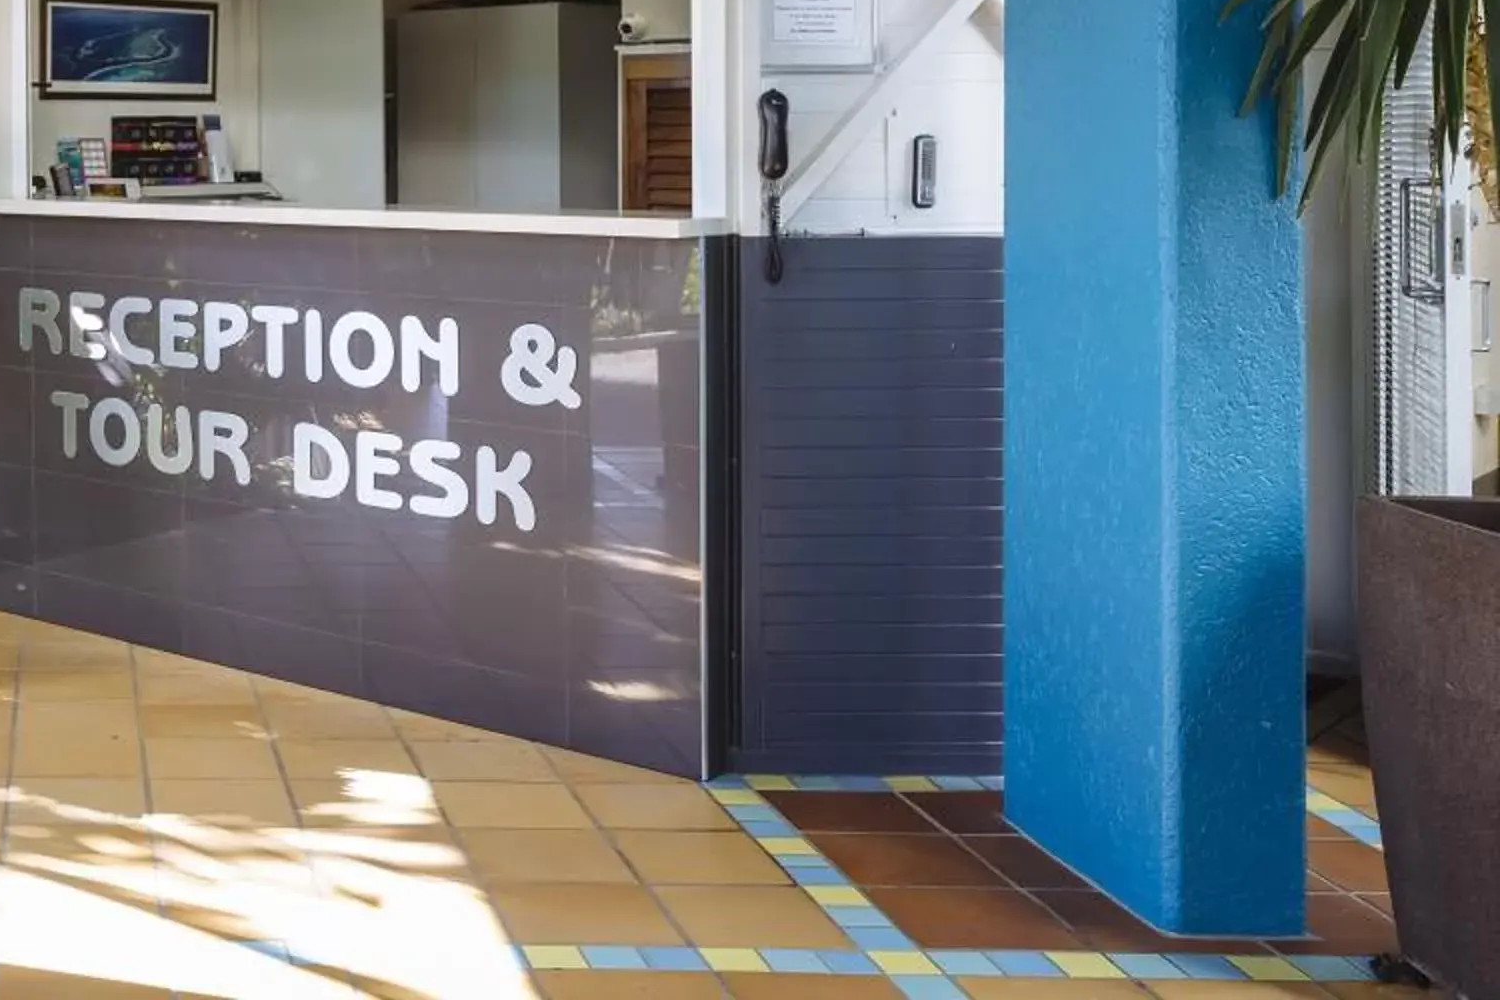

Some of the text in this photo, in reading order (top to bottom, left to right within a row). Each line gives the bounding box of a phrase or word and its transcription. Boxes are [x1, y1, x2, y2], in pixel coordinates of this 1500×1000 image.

[19, 287, 582, 410] RECEPTION &
[50, 391, 537, 533] TOUR DESK
